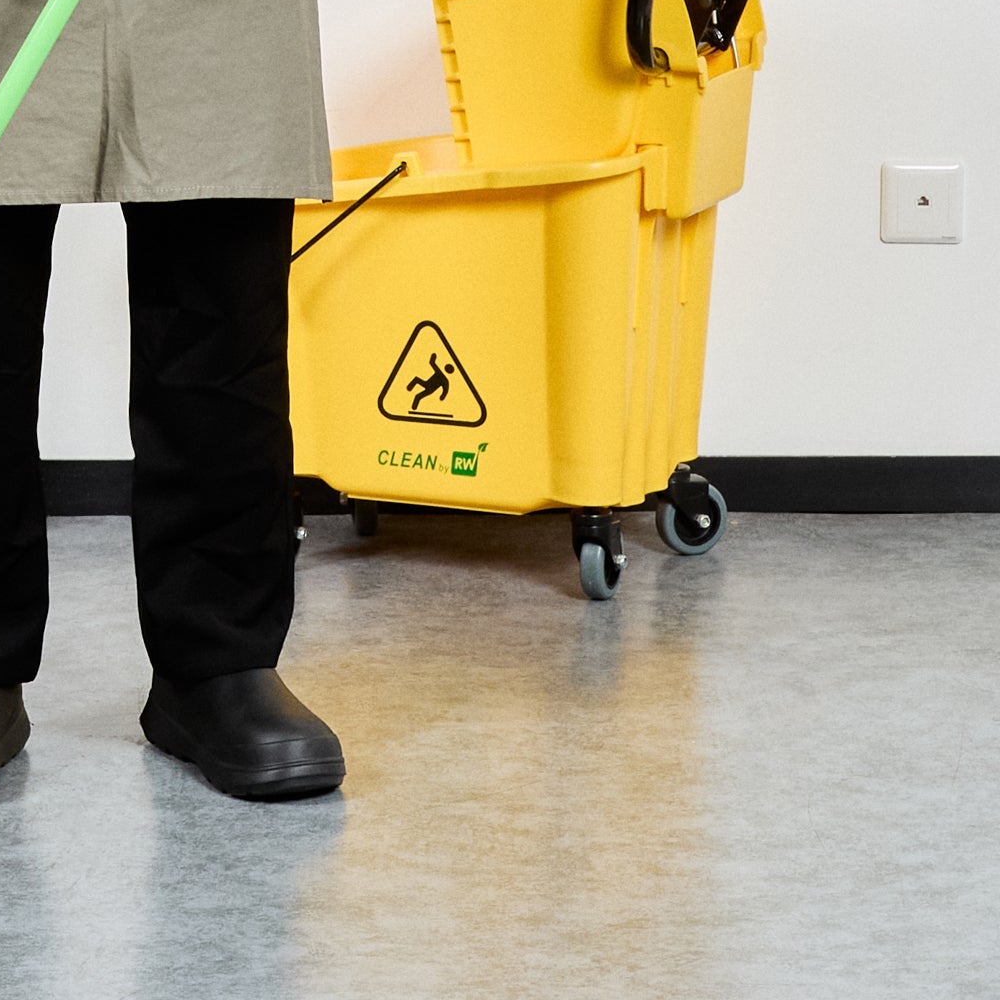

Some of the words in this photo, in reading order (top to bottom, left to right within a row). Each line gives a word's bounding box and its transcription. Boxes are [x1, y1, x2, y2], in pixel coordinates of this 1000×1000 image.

[377, 449, 438, 471] CLEAN
[438, 463, 449, 474] by
[453, 453, 477, 472] RW
